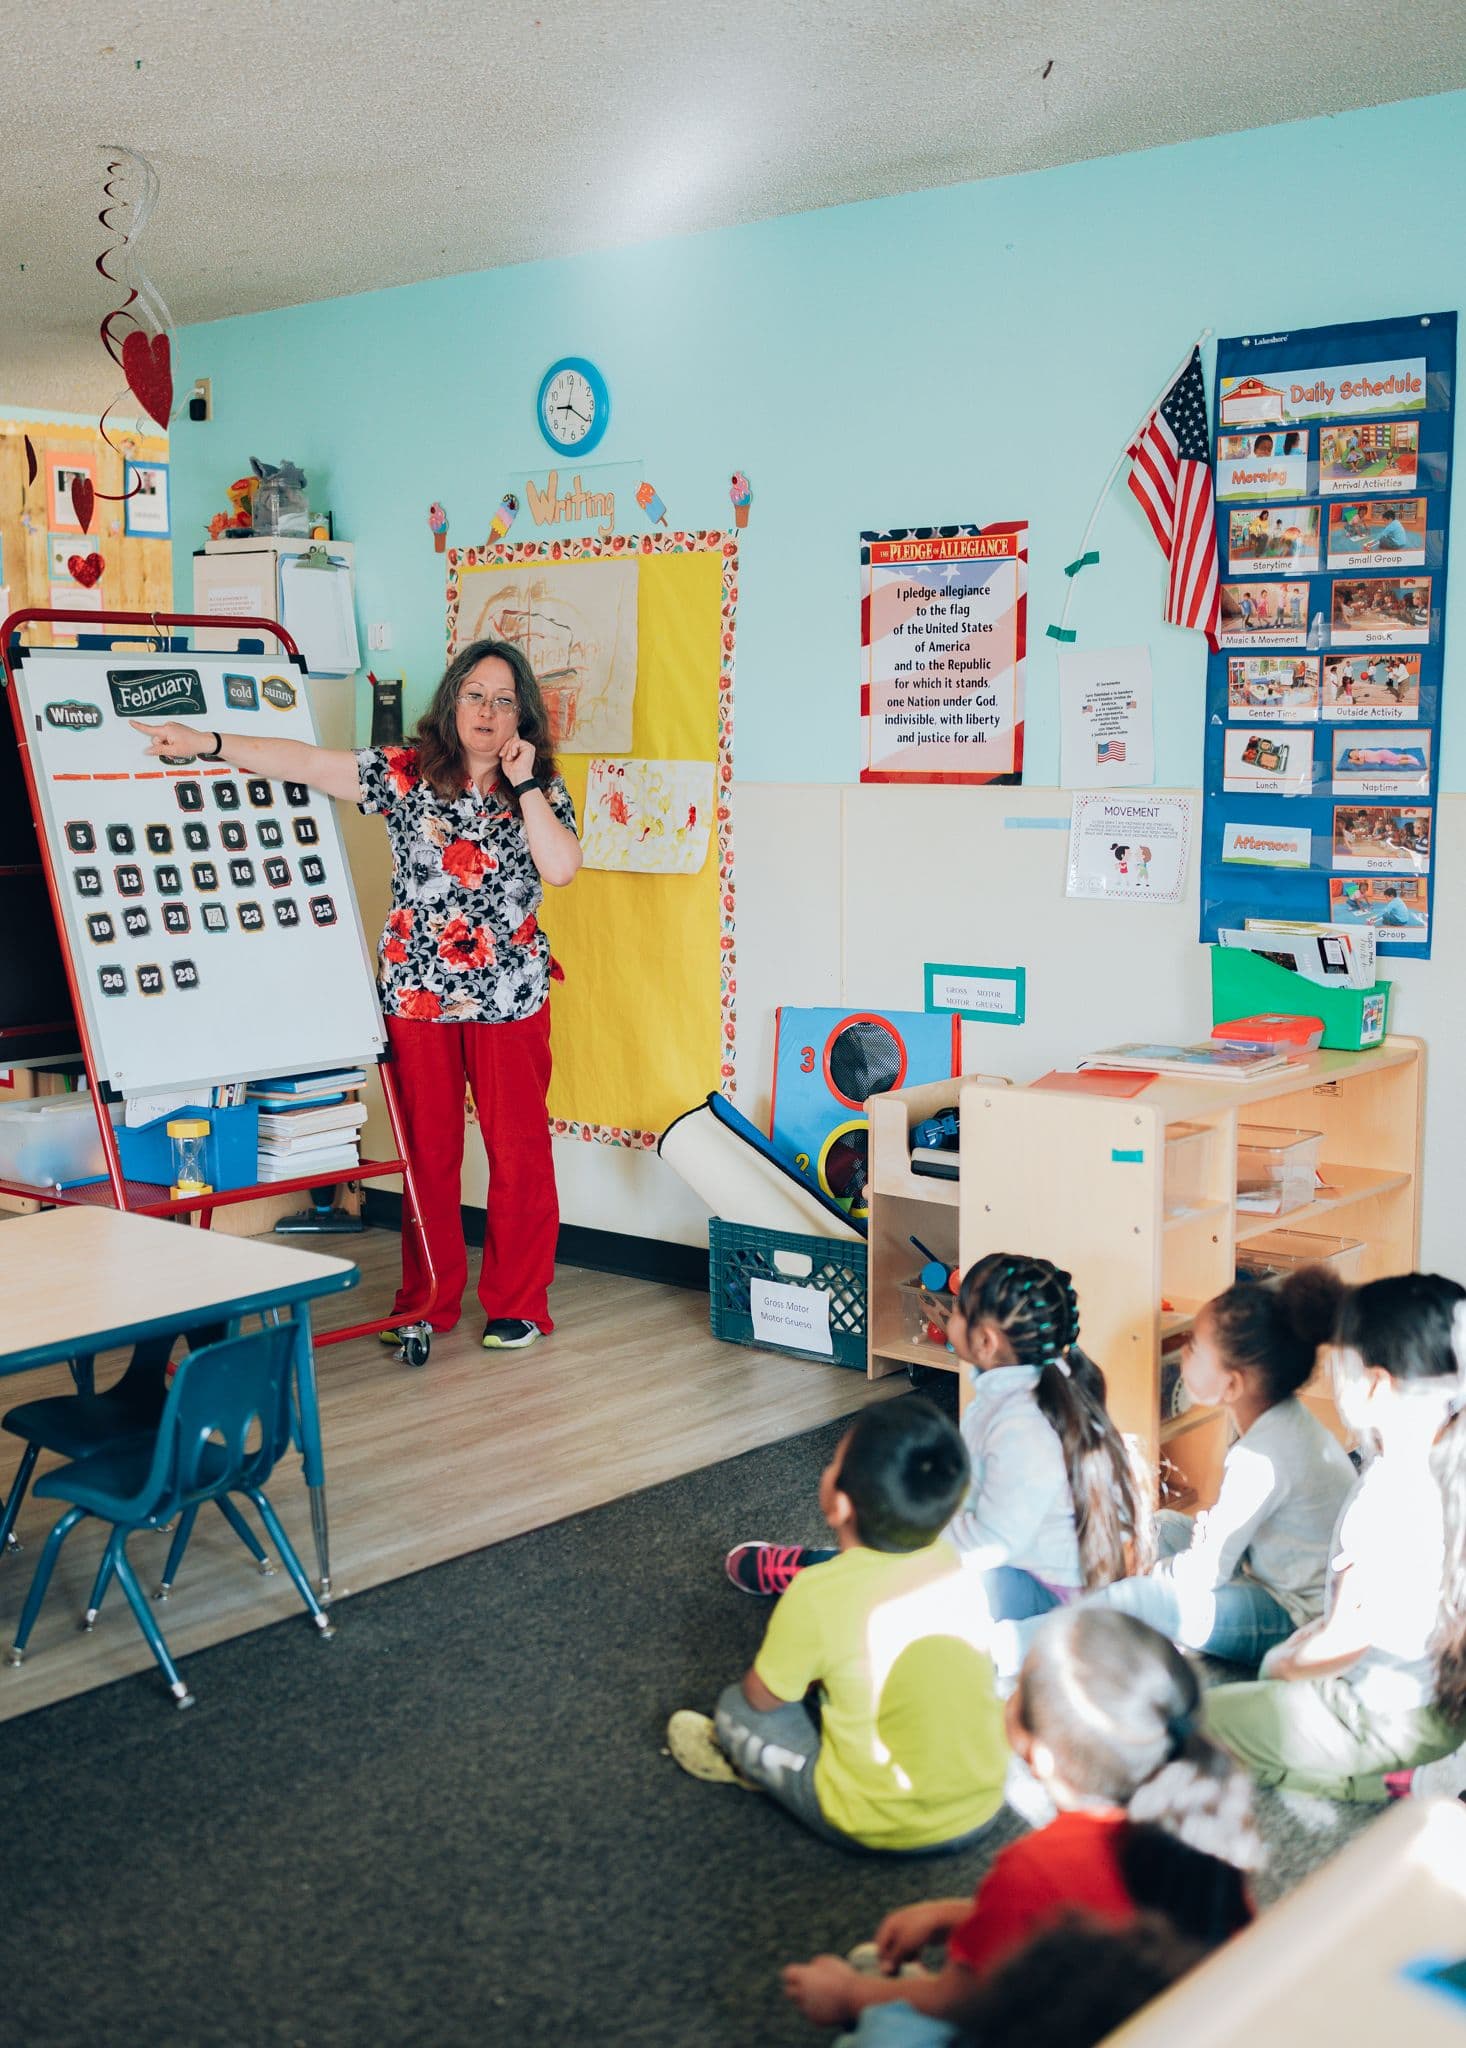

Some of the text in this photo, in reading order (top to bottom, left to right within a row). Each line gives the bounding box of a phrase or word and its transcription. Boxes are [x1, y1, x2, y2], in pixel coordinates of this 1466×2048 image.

[1254, 334, 1288, 346] Lakeshore
[559, 379, 564, 389] 11
[567, 374, 574, 386] 12
[586, 386, 592, 397] 2
[1290, 372, 1422, 405] Daily Schedule
[552, 391, 558, 401] 10
[550, 405, 554, 414] 9
[590, 400, 594, 410] 3
[554, 420, 558, 430] 8
[580, 425, 586, 436] 5
[562, 428, 566, 438] 7
[571, 430, 576, 440] 6
[1232, 467, 1287, 486] Morning
[1332, 479, 1402, 490] Arrival Activities
[526, 470, 615, 535] Writing
[889, 544, 933, 561] PLEDGE
[940, 538, 1008, 558] ALLEGIANCE
[1253, 560, 1292, 572] Storytime
[1348, 555, 1402, 565] Small Group
[896, 585, 990, 602] I pledge allegiance
[916, 604, 970, 618] to the flag
[893, 622, 993, 635] of the United States
[914, 640, 970, 652] of America
[1226, 636, 1298, 645] Music & Movement
[894, 658, 991, 672] and to the Republic
[895, 677, 990, 689] for which it stands,
[119, 676, 194, 708] February
[230, 685, 253, 700] cold
[264, 685, 294, 705] sunny
[887, 696, 998, 708] one Nation under God,
[50, 706, 98, 725] Winter
[1249, 709, 1297, 718] Center Time
[1337, 708, 1402, 719] Outside Activity
[884, 714, 1000, 728] indivisible, with liberty
[897, 732, 987, 746] and justice for all.
[1256, 780, 1278, 790] Lunch
[1362, 782, 1398, 794] Naptime
[186, 789, 194, 803] 1
[222, 789, 232, 802] 2
[256, 787, 265, 800] 3
[292, 787, 301, 800] 4
[1104, 806, 1160, 817] MOVEMENT
[77, 830, 86, 844] 5
[191, 830, 201, 843] 8
[229, 829, 239, 842] 9
[261, 828, 277, 841] 10
[299, 824, 313, 838] 11
[116, 833, 127, 846] 6
[154, 833, 164, 845] 7
[1233, 835, 1298, 853] Afternoon
[305, 863, 322, 877] 18
[1367, 859, 1393, 868] Snack
[198, 869, 214, 883] 15
[234, 866, 251, 880] 16
[271, 865, 286, 879] 17
[80, 875, 98, 889] 12
[121, 874, 139, 888] 13
[160, 873, 177, 887] 14
[242, 910, 260, 924] 23
[278, 907, 296, 920] 24
[314, 905, 332, 918] 25
[127, 914, 147, 929] 20
[168, 912, 185, 926] 21
[94, 922, 110, 936] 19
[1378, 929, 1406, 940] Group
[103, 974, 123, 987] 26
[141, 973, 160, 987] 27
[176, 968, 195, 981] 28
[946, 986, 1001, 998] GROSS MOTOR
[946, 998, 1003, 1009] MOTOR GRUESO
[800, 1046, 816, 1073] 3
[795, 1153, 810, 1176] 2
[764, 1297, 810, 1314] Gross Motor
[760, 1312, 812, 1329] Motor Grueso
